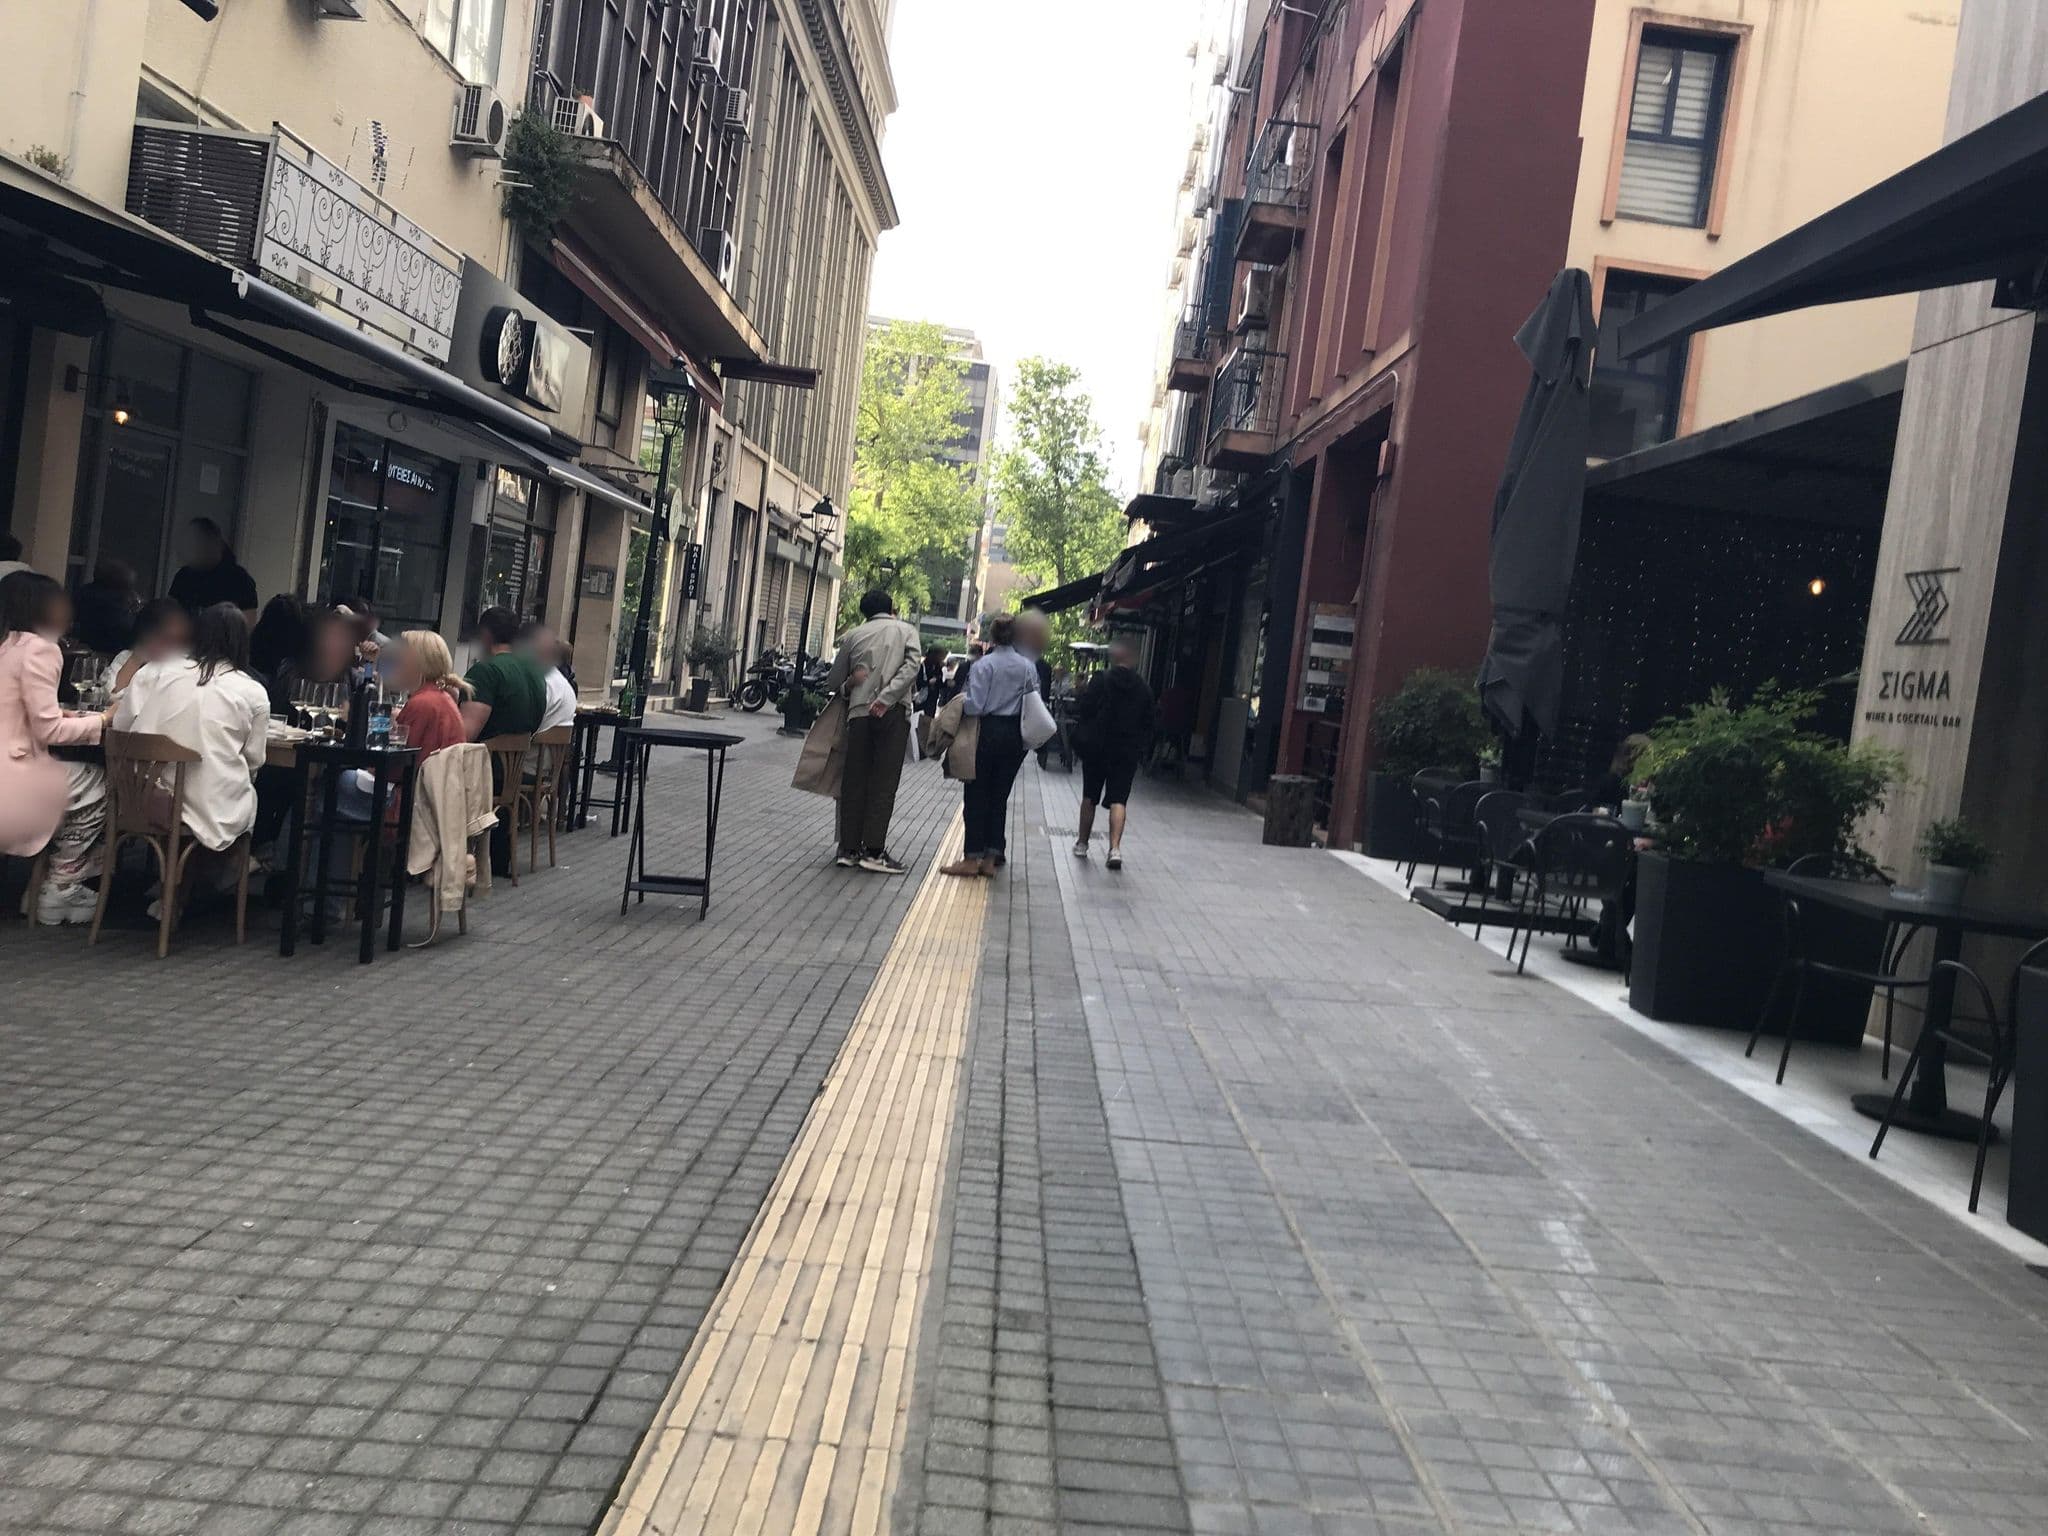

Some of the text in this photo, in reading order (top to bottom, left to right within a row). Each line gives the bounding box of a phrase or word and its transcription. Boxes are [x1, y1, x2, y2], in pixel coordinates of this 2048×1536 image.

[691, 545, 699, 570] NAIL
[1865, 711, 1886, 722] WINE
[1896, 712, 1938, 728] COCKTAIL
[1942, 714, 1961, 728] BAR
